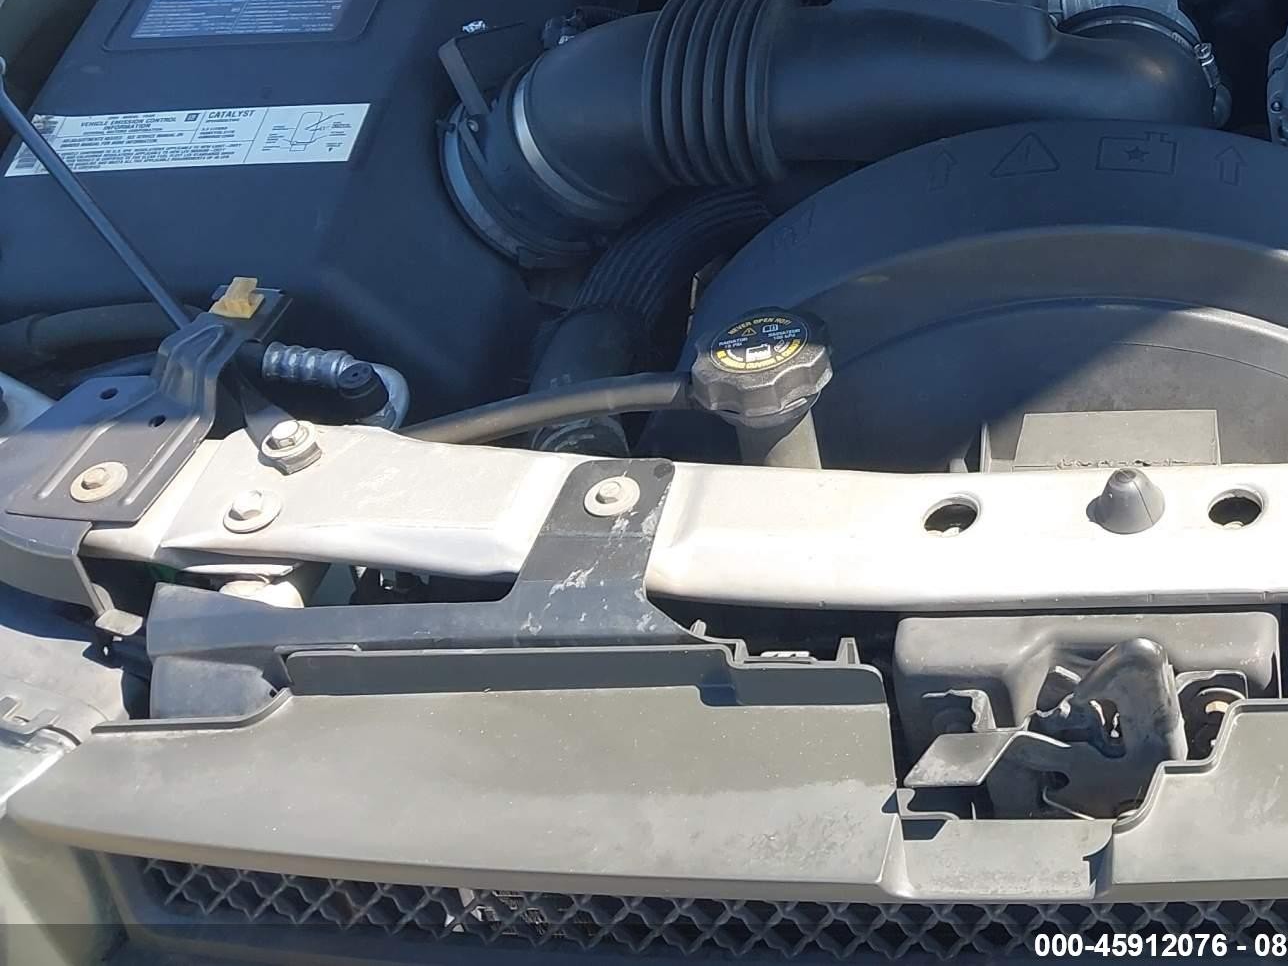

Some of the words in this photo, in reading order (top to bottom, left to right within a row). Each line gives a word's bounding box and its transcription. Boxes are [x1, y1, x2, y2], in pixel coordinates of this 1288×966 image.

[208, 109, 256, 119] CATALYST
[110, 118, 145, 126] EMISSION
[728, 321, 752, 335] NEVER
